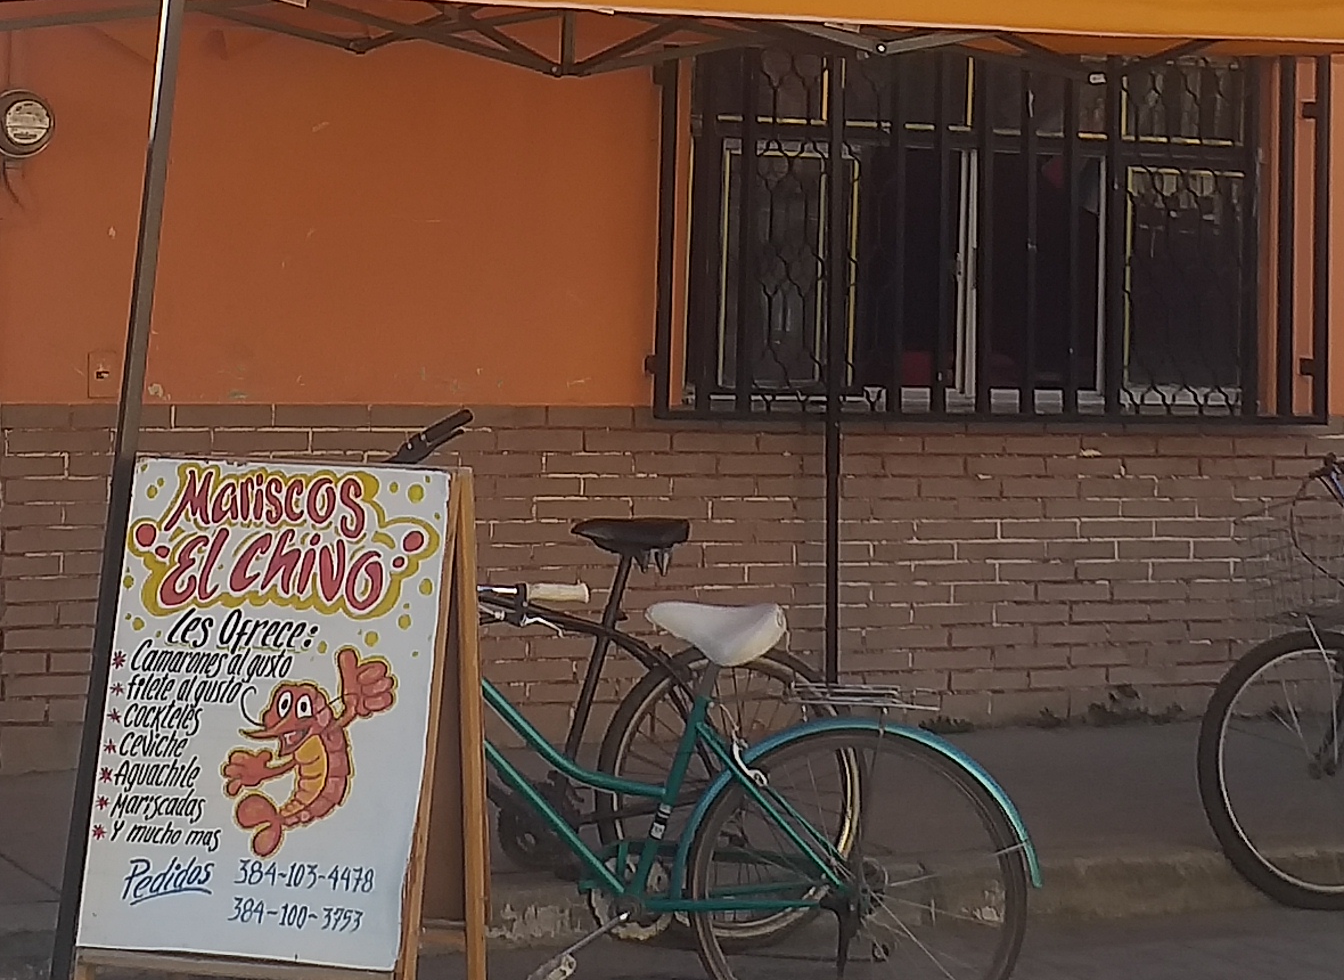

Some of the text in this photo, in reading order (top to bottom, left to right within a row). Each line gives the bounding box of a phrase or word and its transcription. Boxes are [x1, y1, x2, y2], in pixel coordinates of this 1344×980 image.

[164, 469, 366, 539] Mariscos
[158, 527, 230, 608] El
[167, 607, 320, 654] Les Ofrece:
[130, 639, 293, 684] Camarones al gusto
[176, 675, 198, 702] al
[190, 675, 244, 710] gusto
[113, 755, 201, 793] Aguachile
[109, 788, 206, 824] Mariscadas
[110, 820, 222, 852] Y mucho mas
[121, 856, 215, 900] Pedidos
